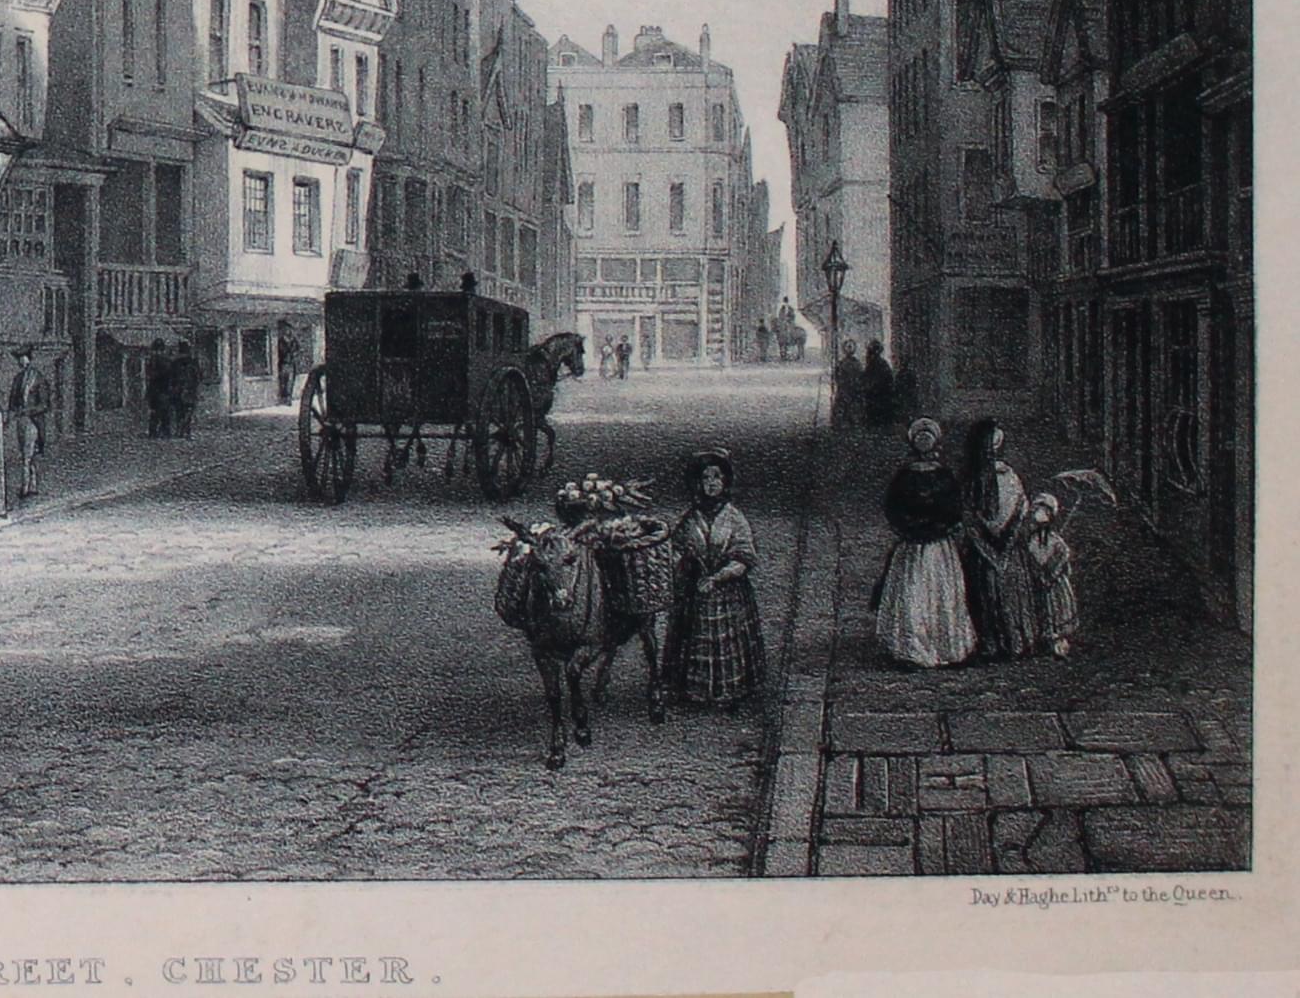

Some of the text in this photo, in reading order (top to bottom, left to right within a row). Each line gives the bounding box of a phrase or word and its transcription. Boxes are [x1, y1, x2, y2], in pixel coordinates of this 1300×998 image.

[971, 887, 999, 907] Day
[1004, 887, 1017, 905] &
[1018, 887, 1069, 909] Haghe
[1123, 887, 1138, 902] to
[1142, 886, 1170, 902] the
